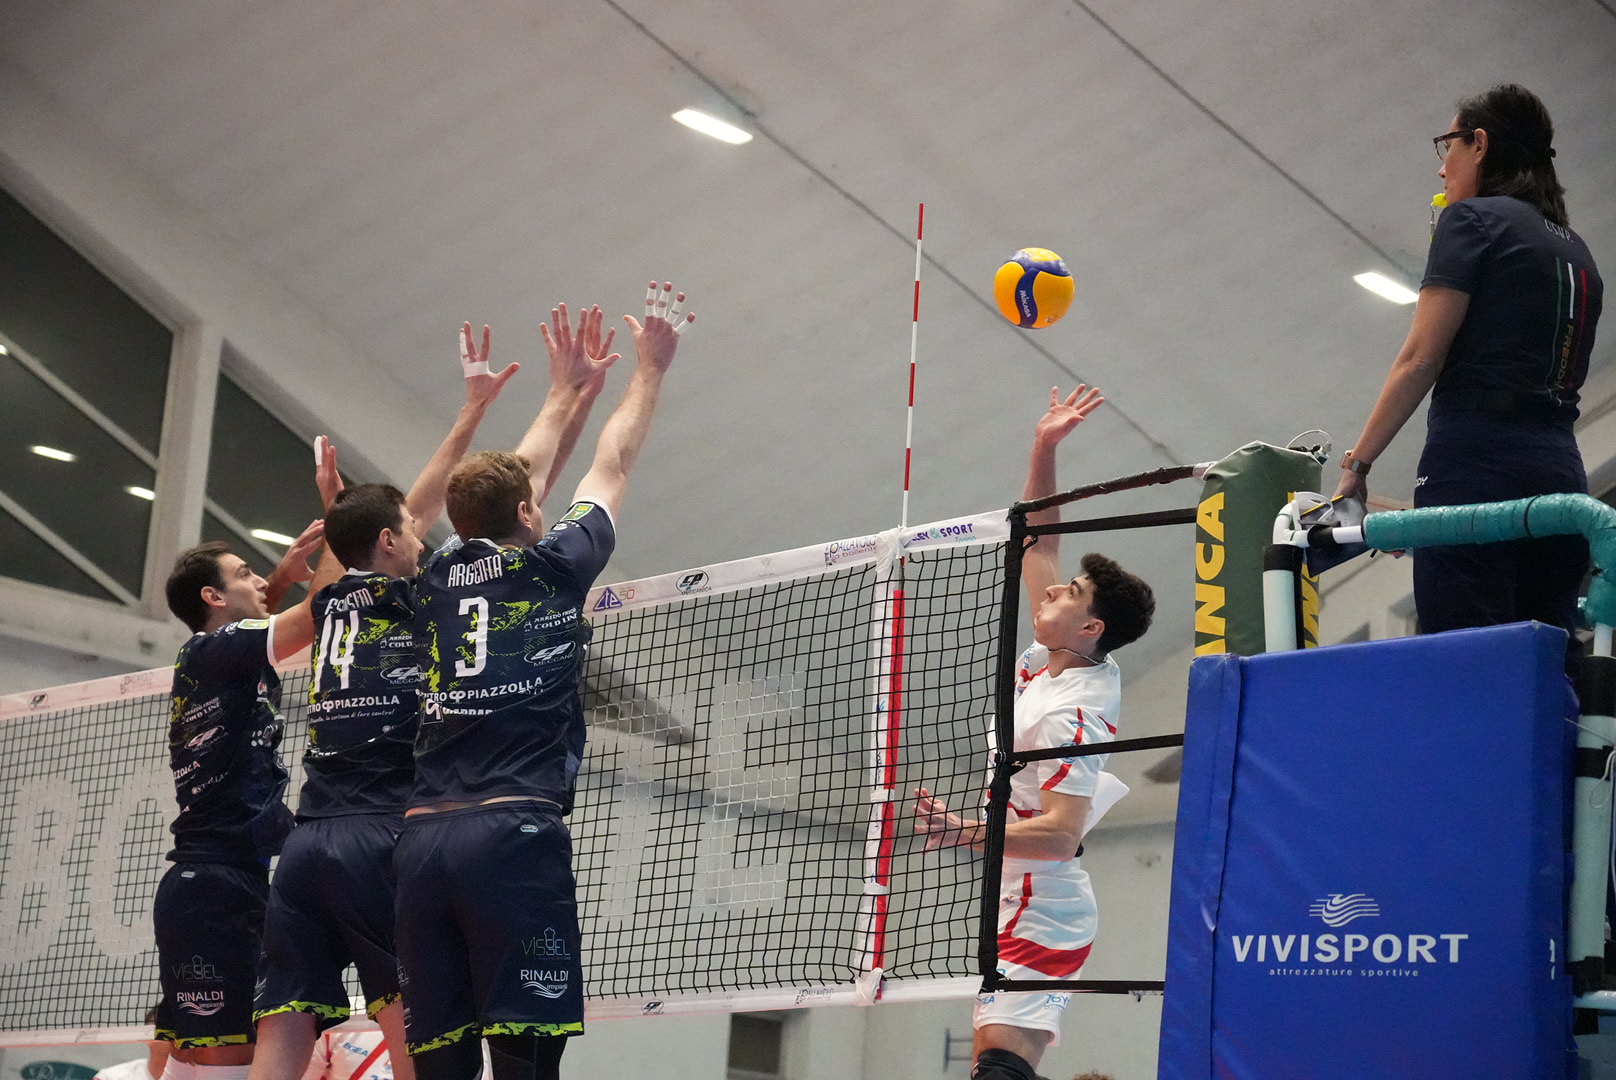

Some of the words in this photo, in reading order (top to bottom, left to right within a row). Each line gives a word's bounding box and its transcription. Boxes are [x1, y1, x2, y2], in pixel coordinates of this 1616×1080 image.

[1554, 323, 1574, 390] FREDDY
[940, 523, 973, 537] SPORT
[447, 554, 503, 588] ARGENTA
[534, 620, 561, 630] COLD
[455, 596, 490, 678] 3
[314, 610, 359, 693] 14
[388, 641, 413, 649] COLD
[467, 677, 543, 699] PIAZZOLLA
[335, 695, 400, 709] PIAZZOLLA
[1232, 933, 1469, 963] VIVISPORT
[520, 969, 569, 982] RINALDI
[1269, 967, 1353, 977] attrezzature
[1361, 967, 1419, 979] sportive
[177, 991, 224, 1002] RINALDI
